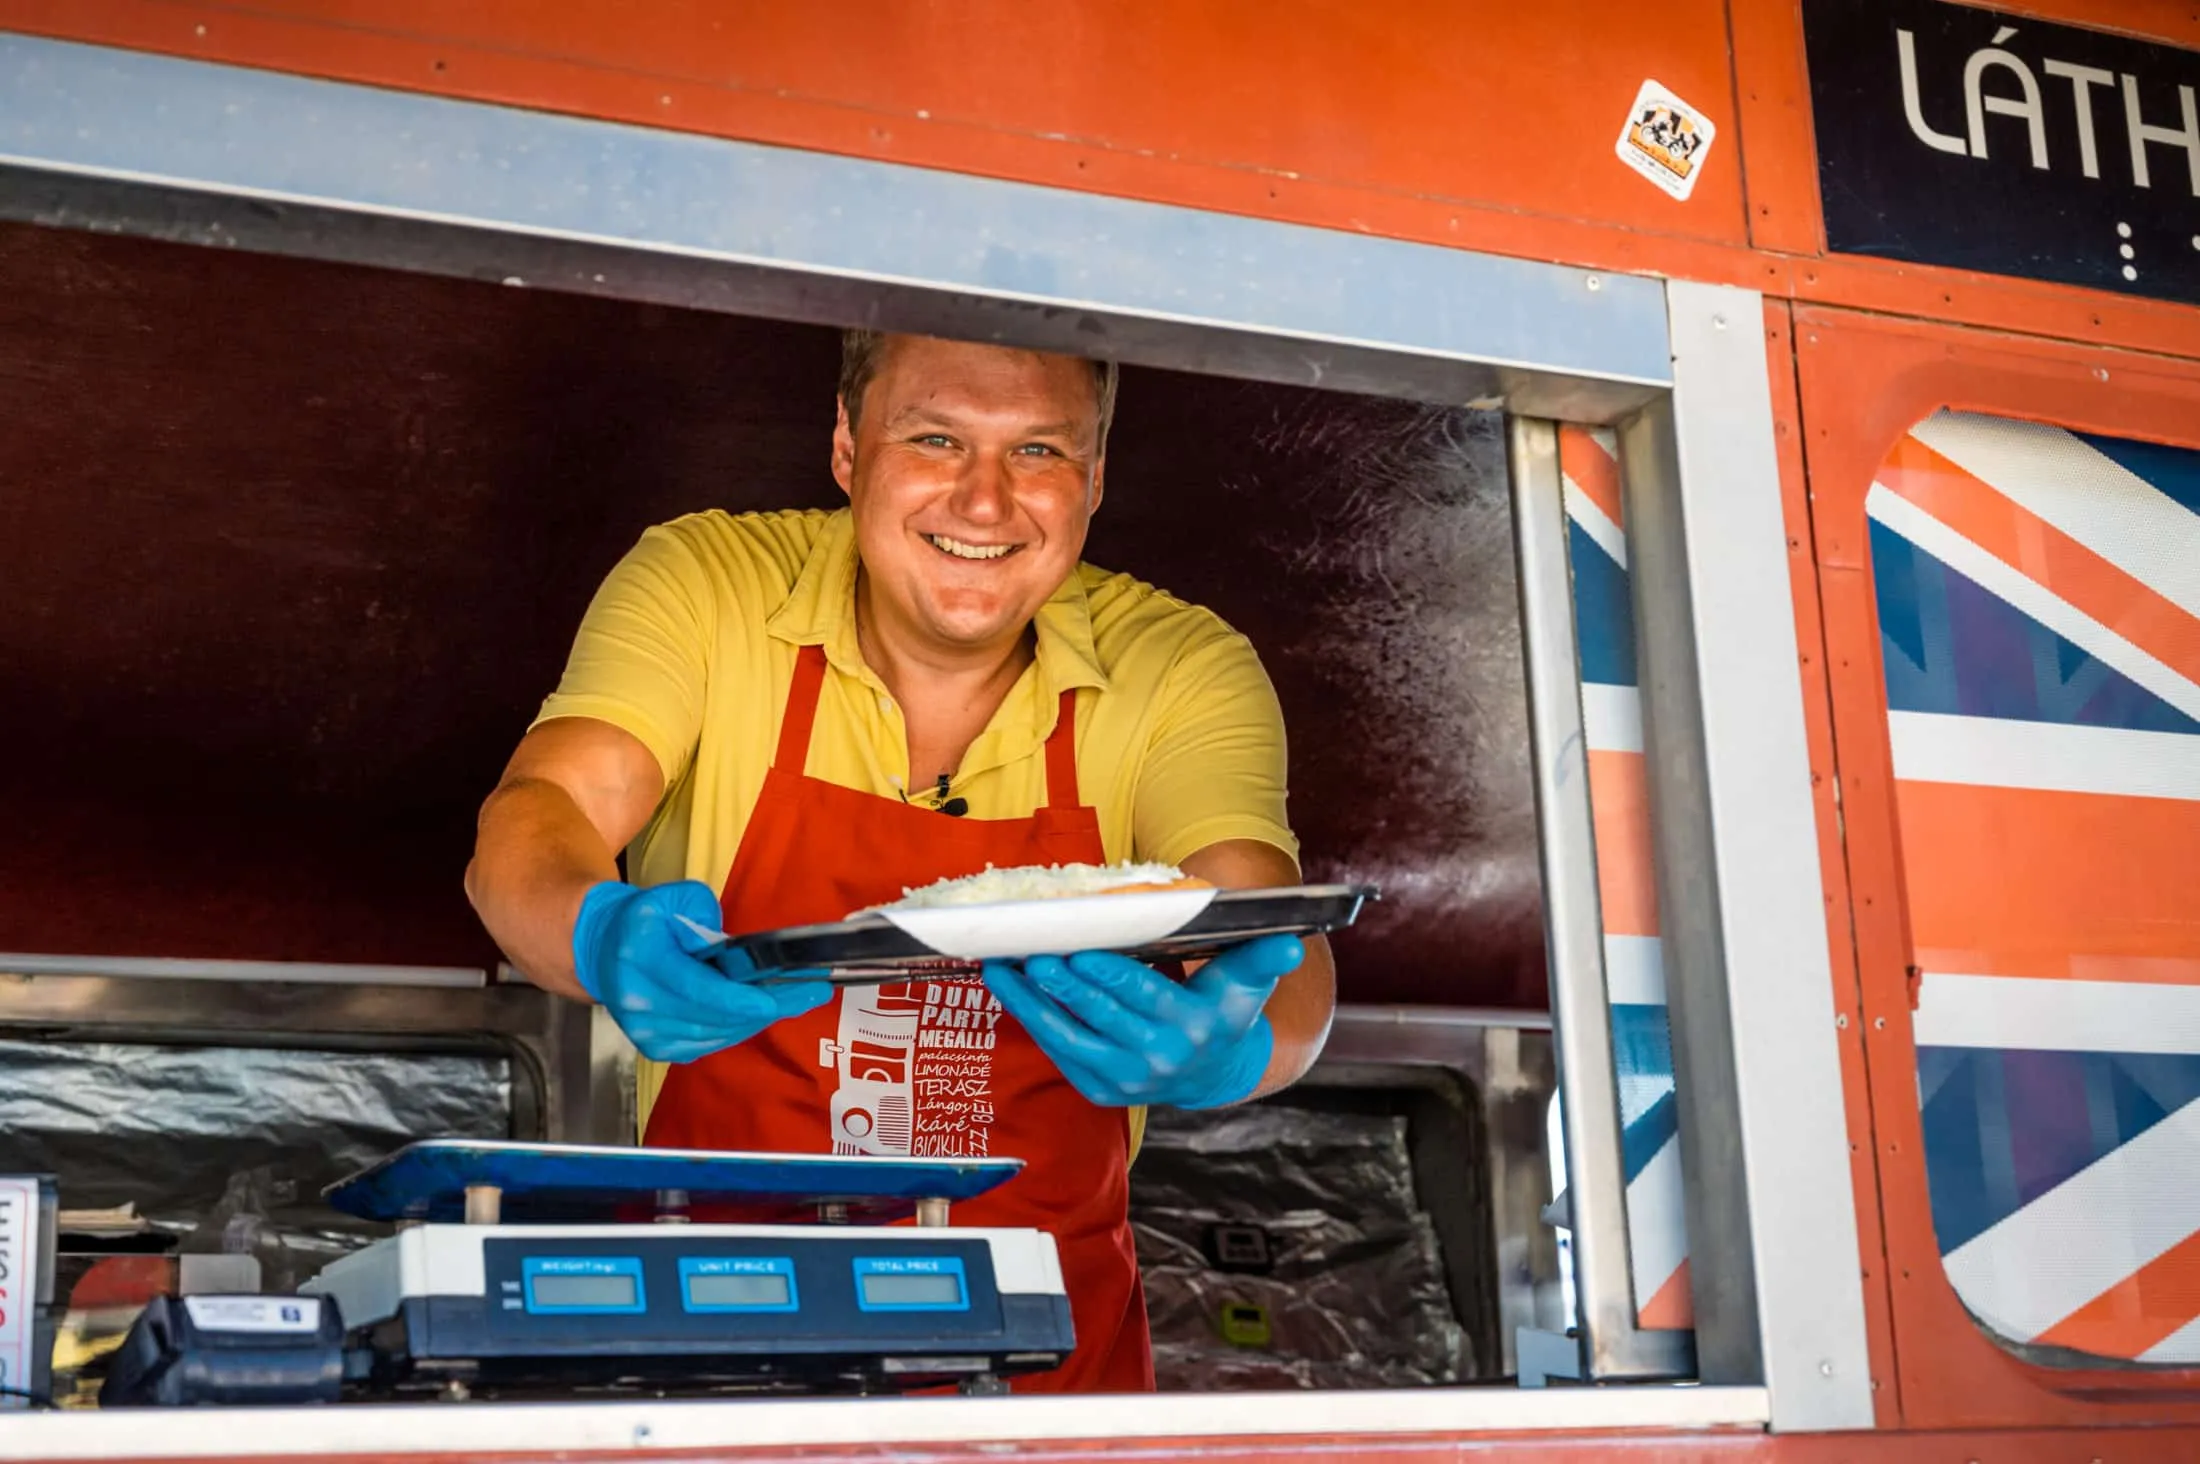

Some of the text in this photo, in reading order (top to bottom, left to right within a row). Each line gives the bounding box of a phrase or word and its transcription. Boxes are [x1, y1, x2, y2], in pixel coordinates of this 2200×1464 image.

[1897, 26, 2200, 198] LÁTH
[925, 983, 1003, 1012] DUNA
[921, 1004, 1003, 1030] PARTY
[918, 1027, 996, 1050] MEGÁLLÓ
[917, 1050, 993, 1062] palacsinta
[914, 1062, 992, 1077] LIMONÁDÉ
[914, 1079, 993, 1097] TERASZ
[917, 1097, 973, 1115] Lángos
[916, 1113, 970, 1134] kávé
[734, 1260, 776, 1272] PRICE
[871, 1261, 939, 1272] TOTAL PRICE
